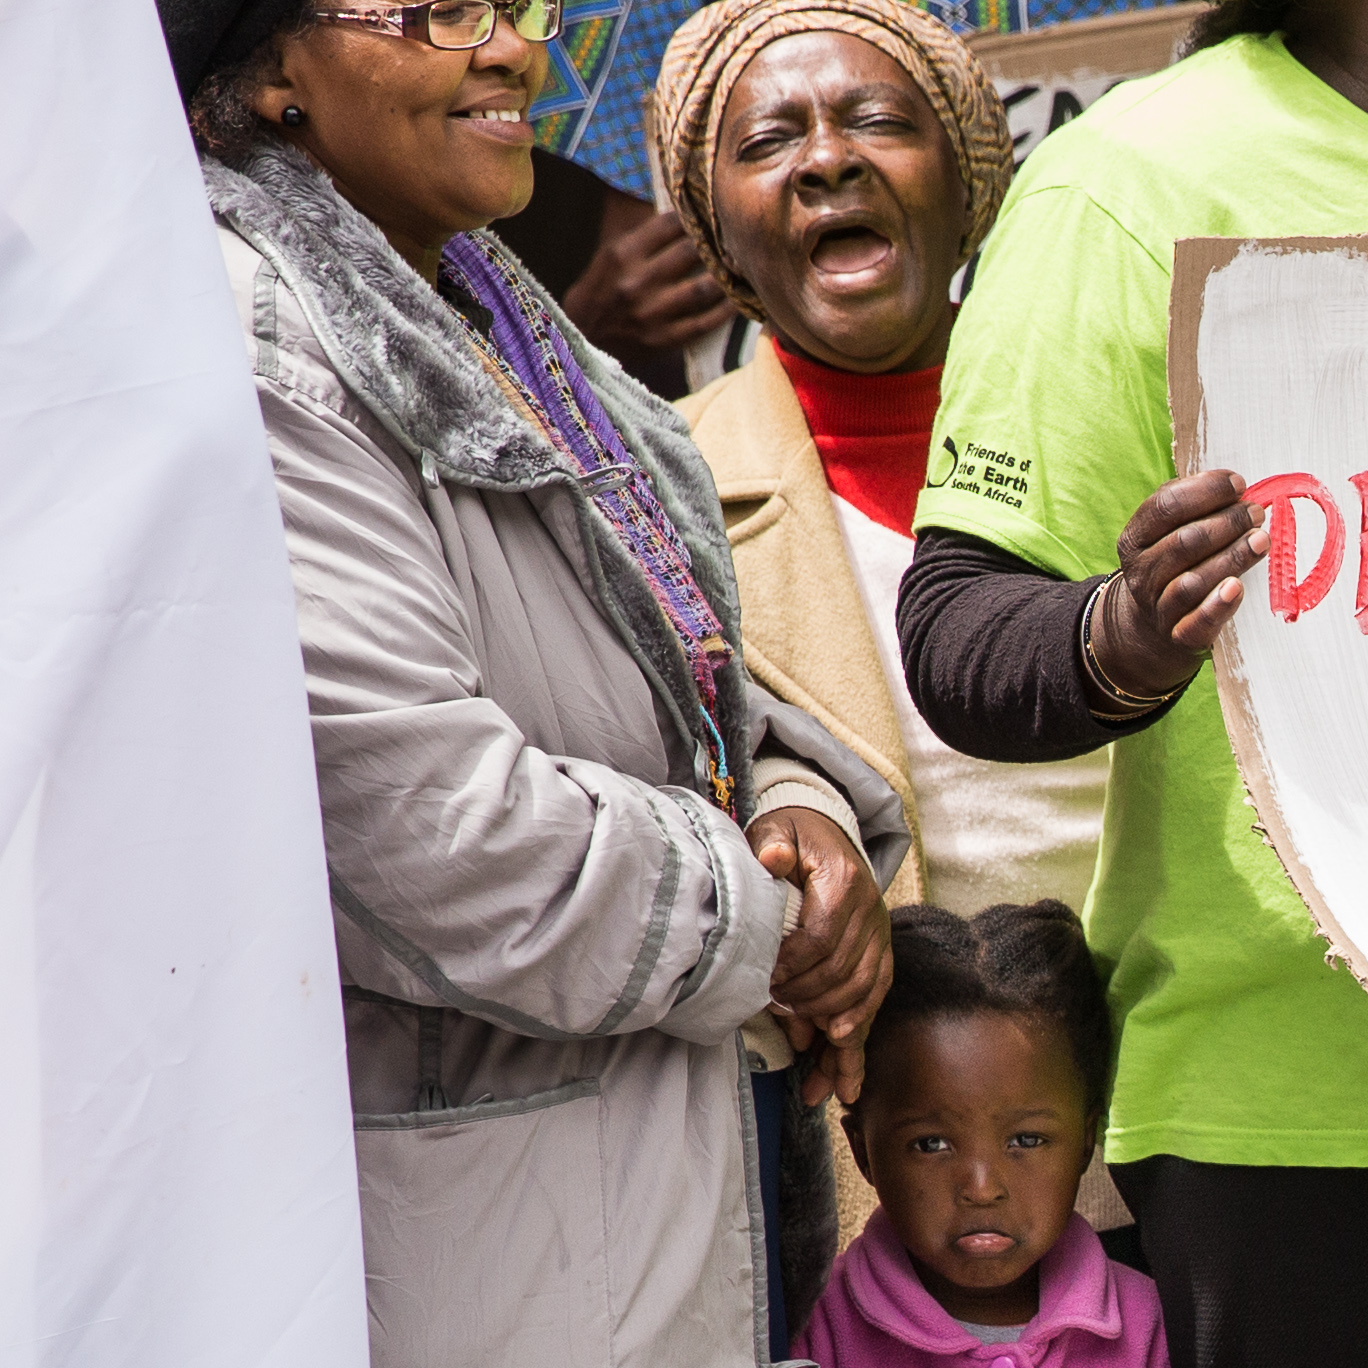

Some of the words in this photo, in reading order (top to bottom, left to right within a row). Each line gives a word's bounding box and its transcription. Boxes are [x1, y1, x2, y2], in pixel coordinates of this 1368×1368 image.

[966, 443, 1016, 467] Friends
[958, 462, 976, 476] the
[983, 466, 1028, 494] Earth
[951, 479, 980, 494] South
[984, 487, 1023, 508] Africa
